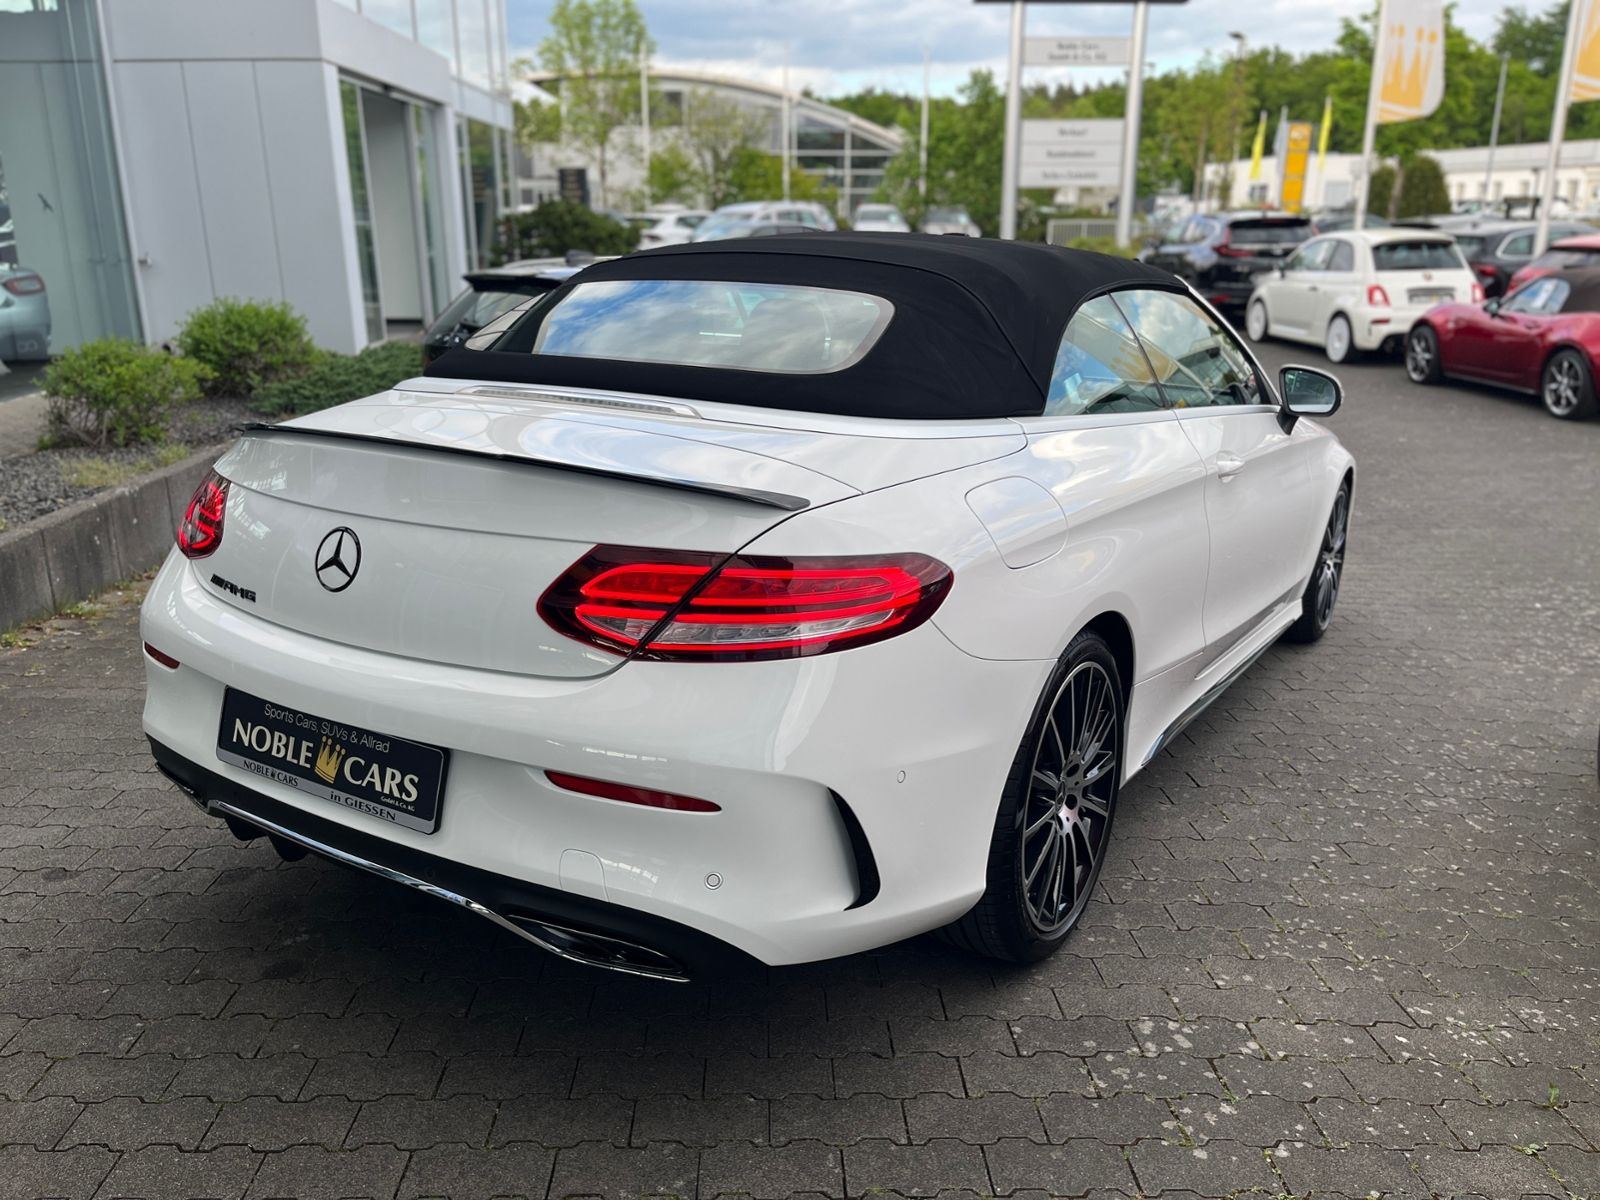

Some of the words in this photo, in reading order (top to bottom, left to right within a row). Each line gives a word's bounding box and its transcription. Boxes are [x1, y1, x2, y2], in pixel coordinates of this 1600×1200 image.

[222, 579, 257, 603] AMG
[264, 704, 294, 724] Sports
[295, 714, 319, 733] Cars,
[320, 722, 348, 741] SUVs
[350, 731, 358, 743] &
[360, 734, 391, 753] Allrad
[232, 717, 313, 769] NOBLE
[344, 756, 420, 802] CARS
[243, 759, 270, 777] NOBLE
[277, 771, 299, 787] CARS
[330, 791, 341, 803] in
[345, 796, 396, 821] GIESSEN
